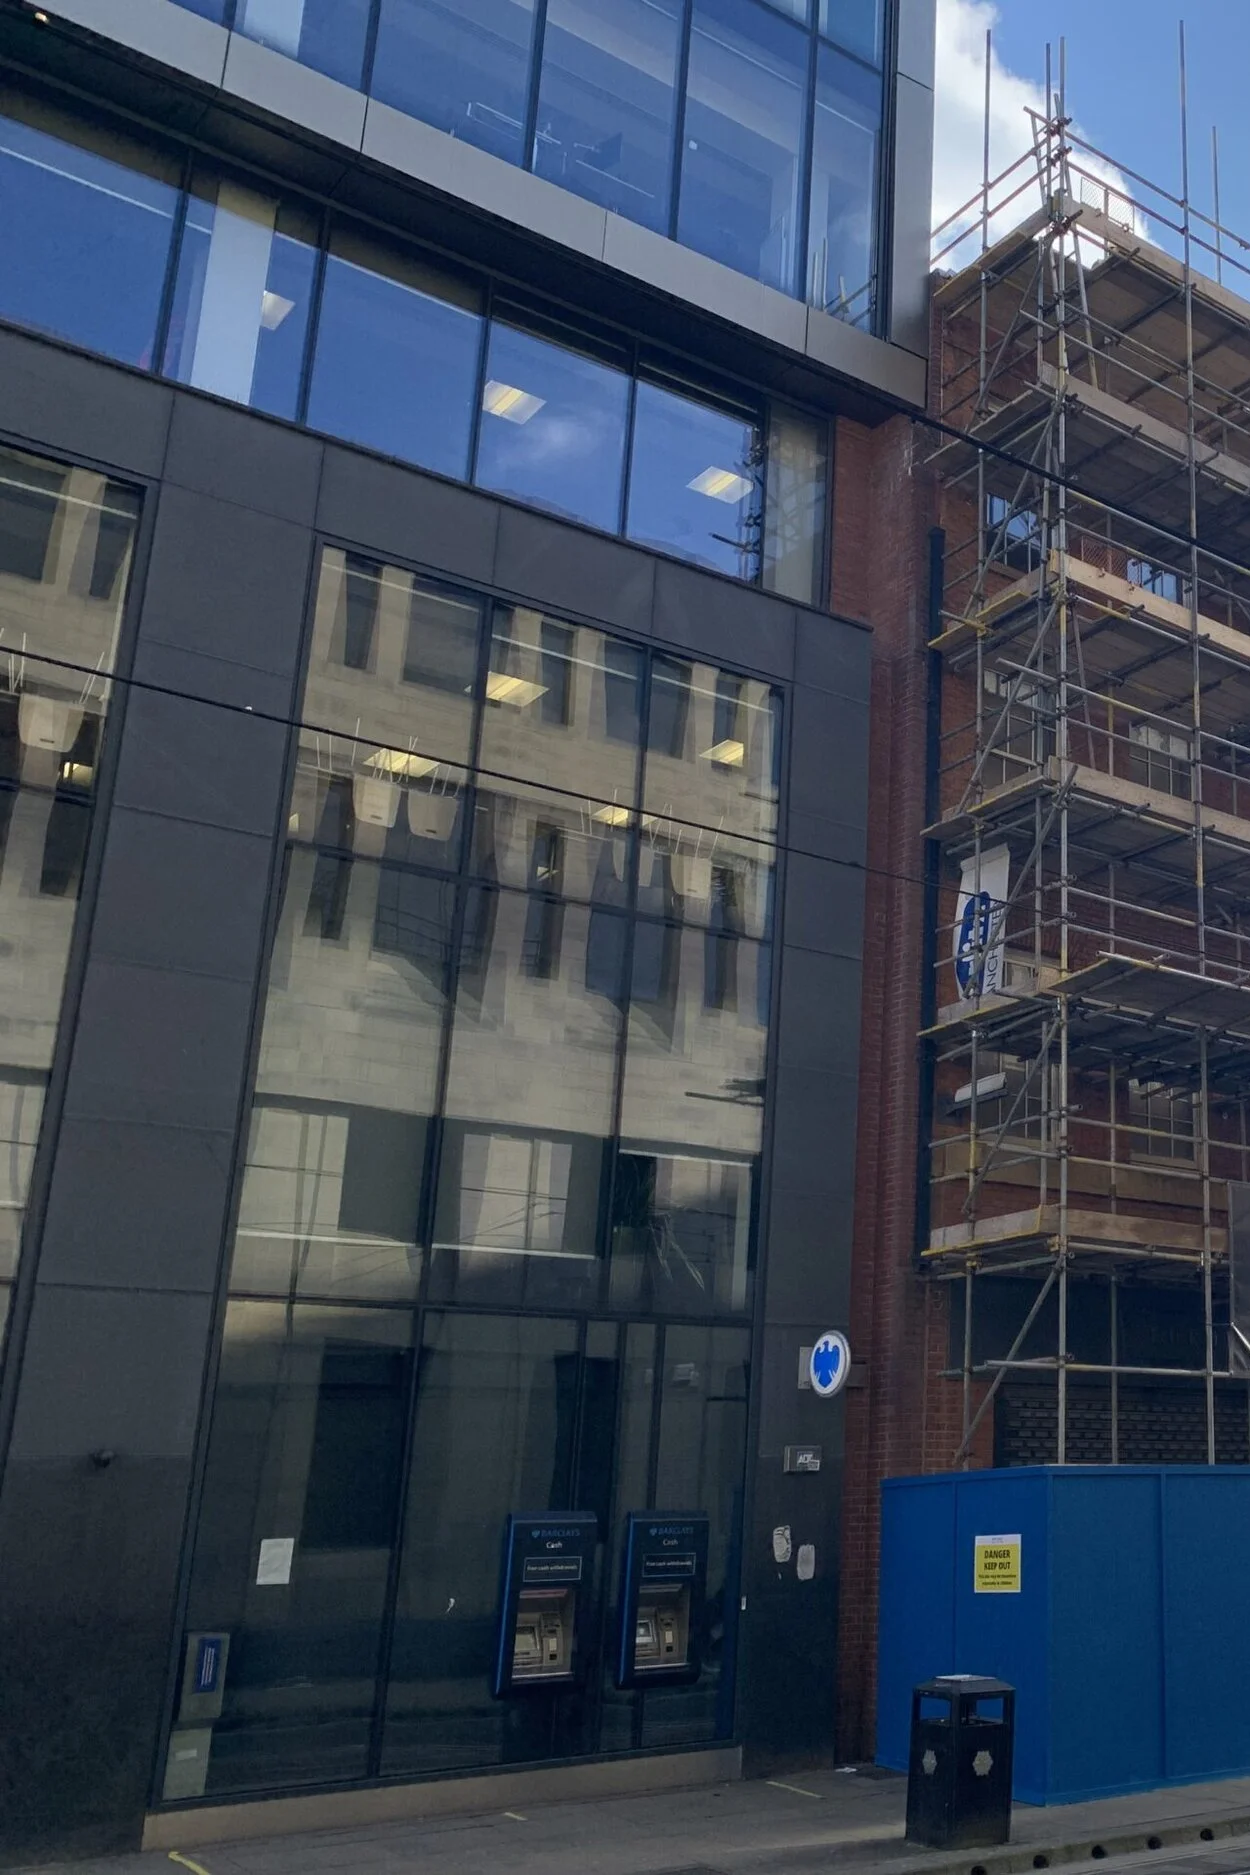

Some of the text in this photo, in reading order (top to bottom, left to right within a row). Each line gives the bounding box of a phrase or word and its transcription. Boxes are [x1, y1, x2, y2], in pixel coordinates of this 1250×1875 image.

[546, 1541, 563, 1549] Cash
[984, 1549, 1011, 1559] DANGER
[983, 1561, 1011, 1571] KEEP OUT
